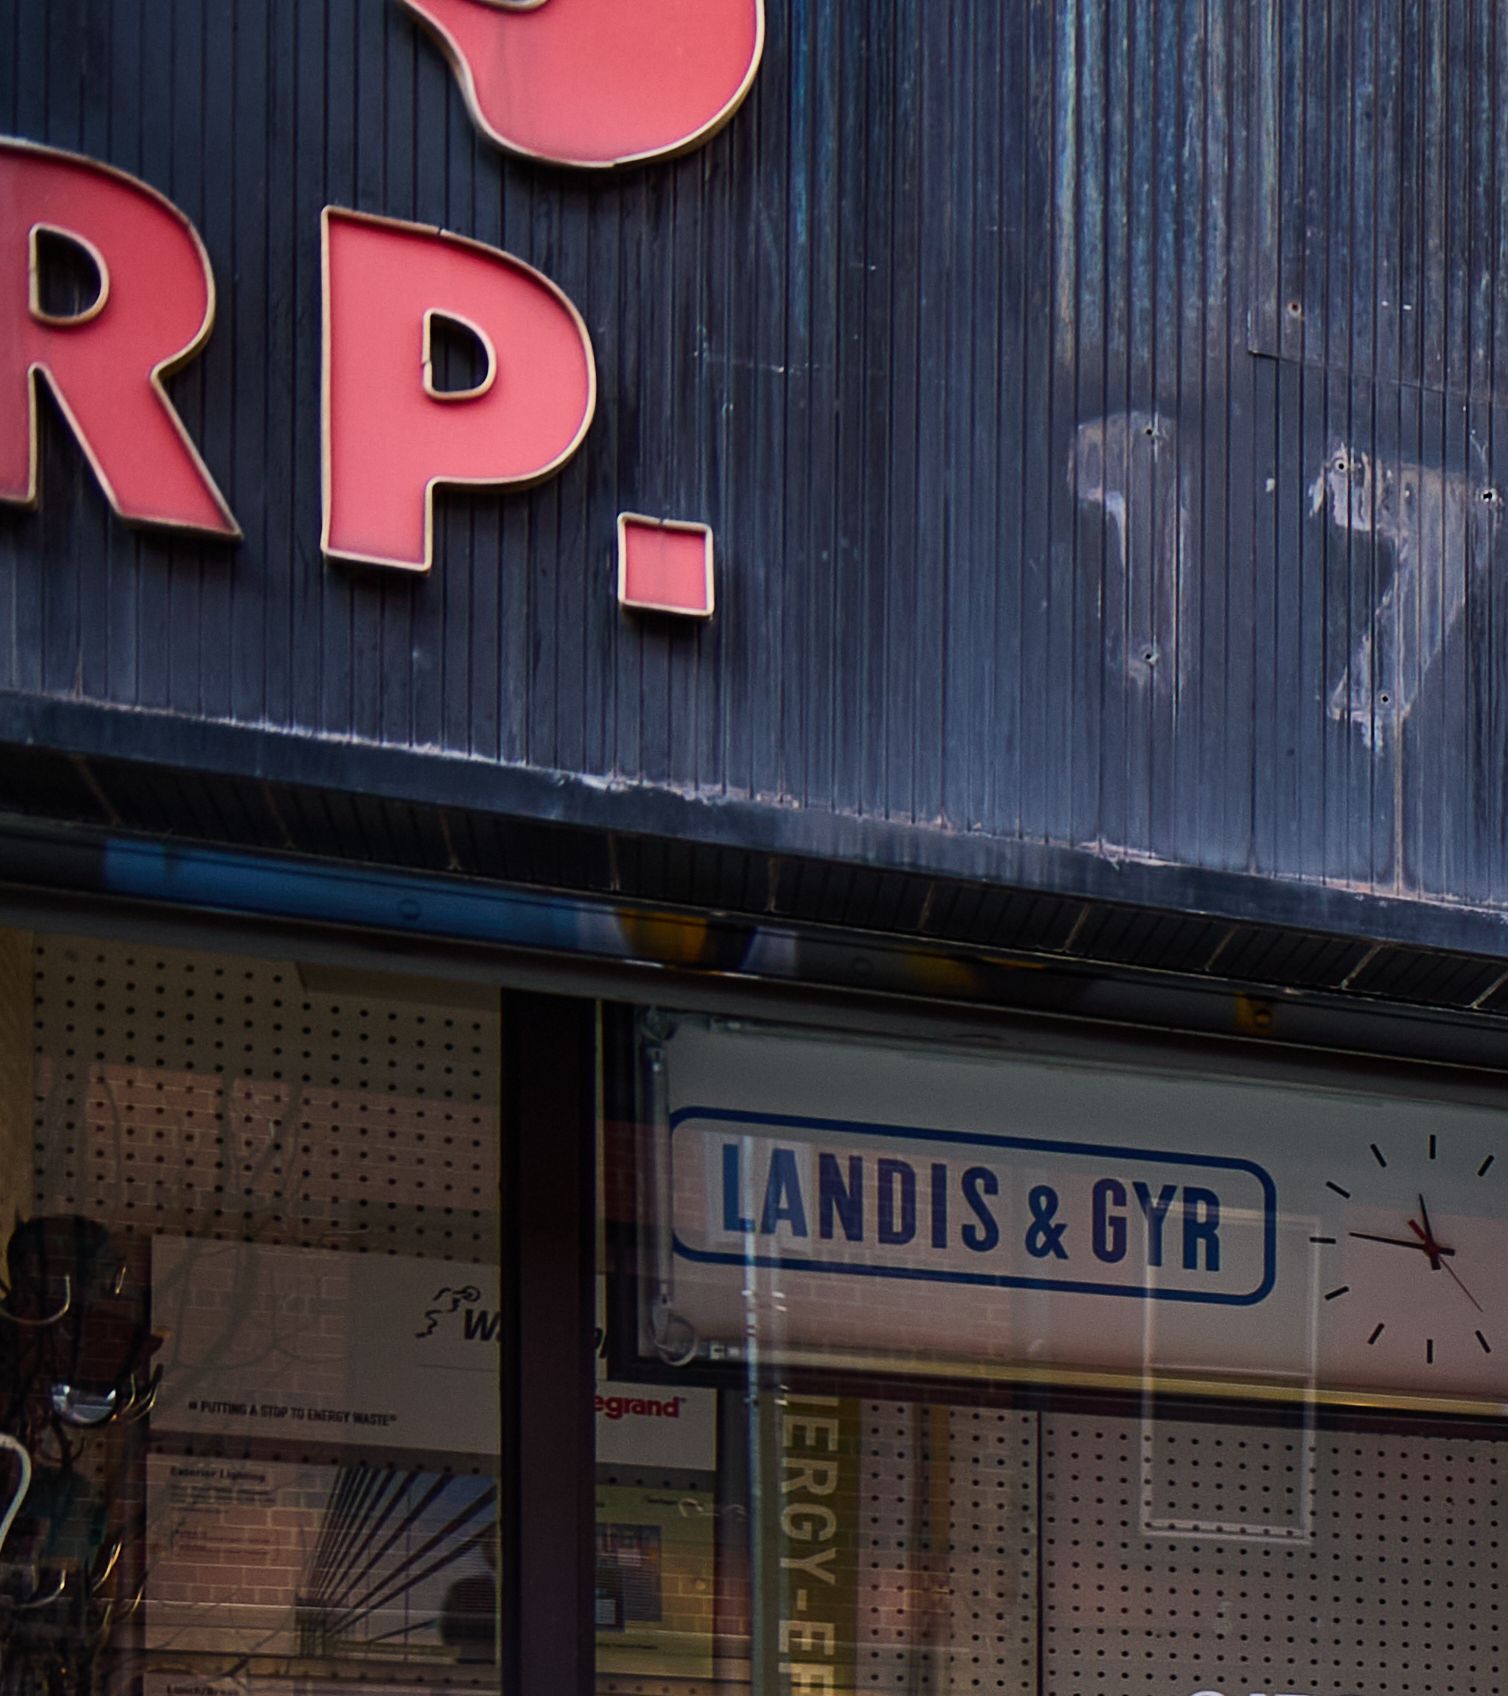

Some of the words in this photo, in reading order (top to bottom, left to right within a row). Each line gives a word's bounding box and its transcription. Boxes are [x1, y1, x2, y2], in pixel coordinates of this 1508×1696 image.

[722, 1142, 999, 1253] LANDIS
[1025, 1185, 1069, 1260] &
[1092, 1177, 1221, 1272] GYR
[595, 1394, 680, 1419] egrand
